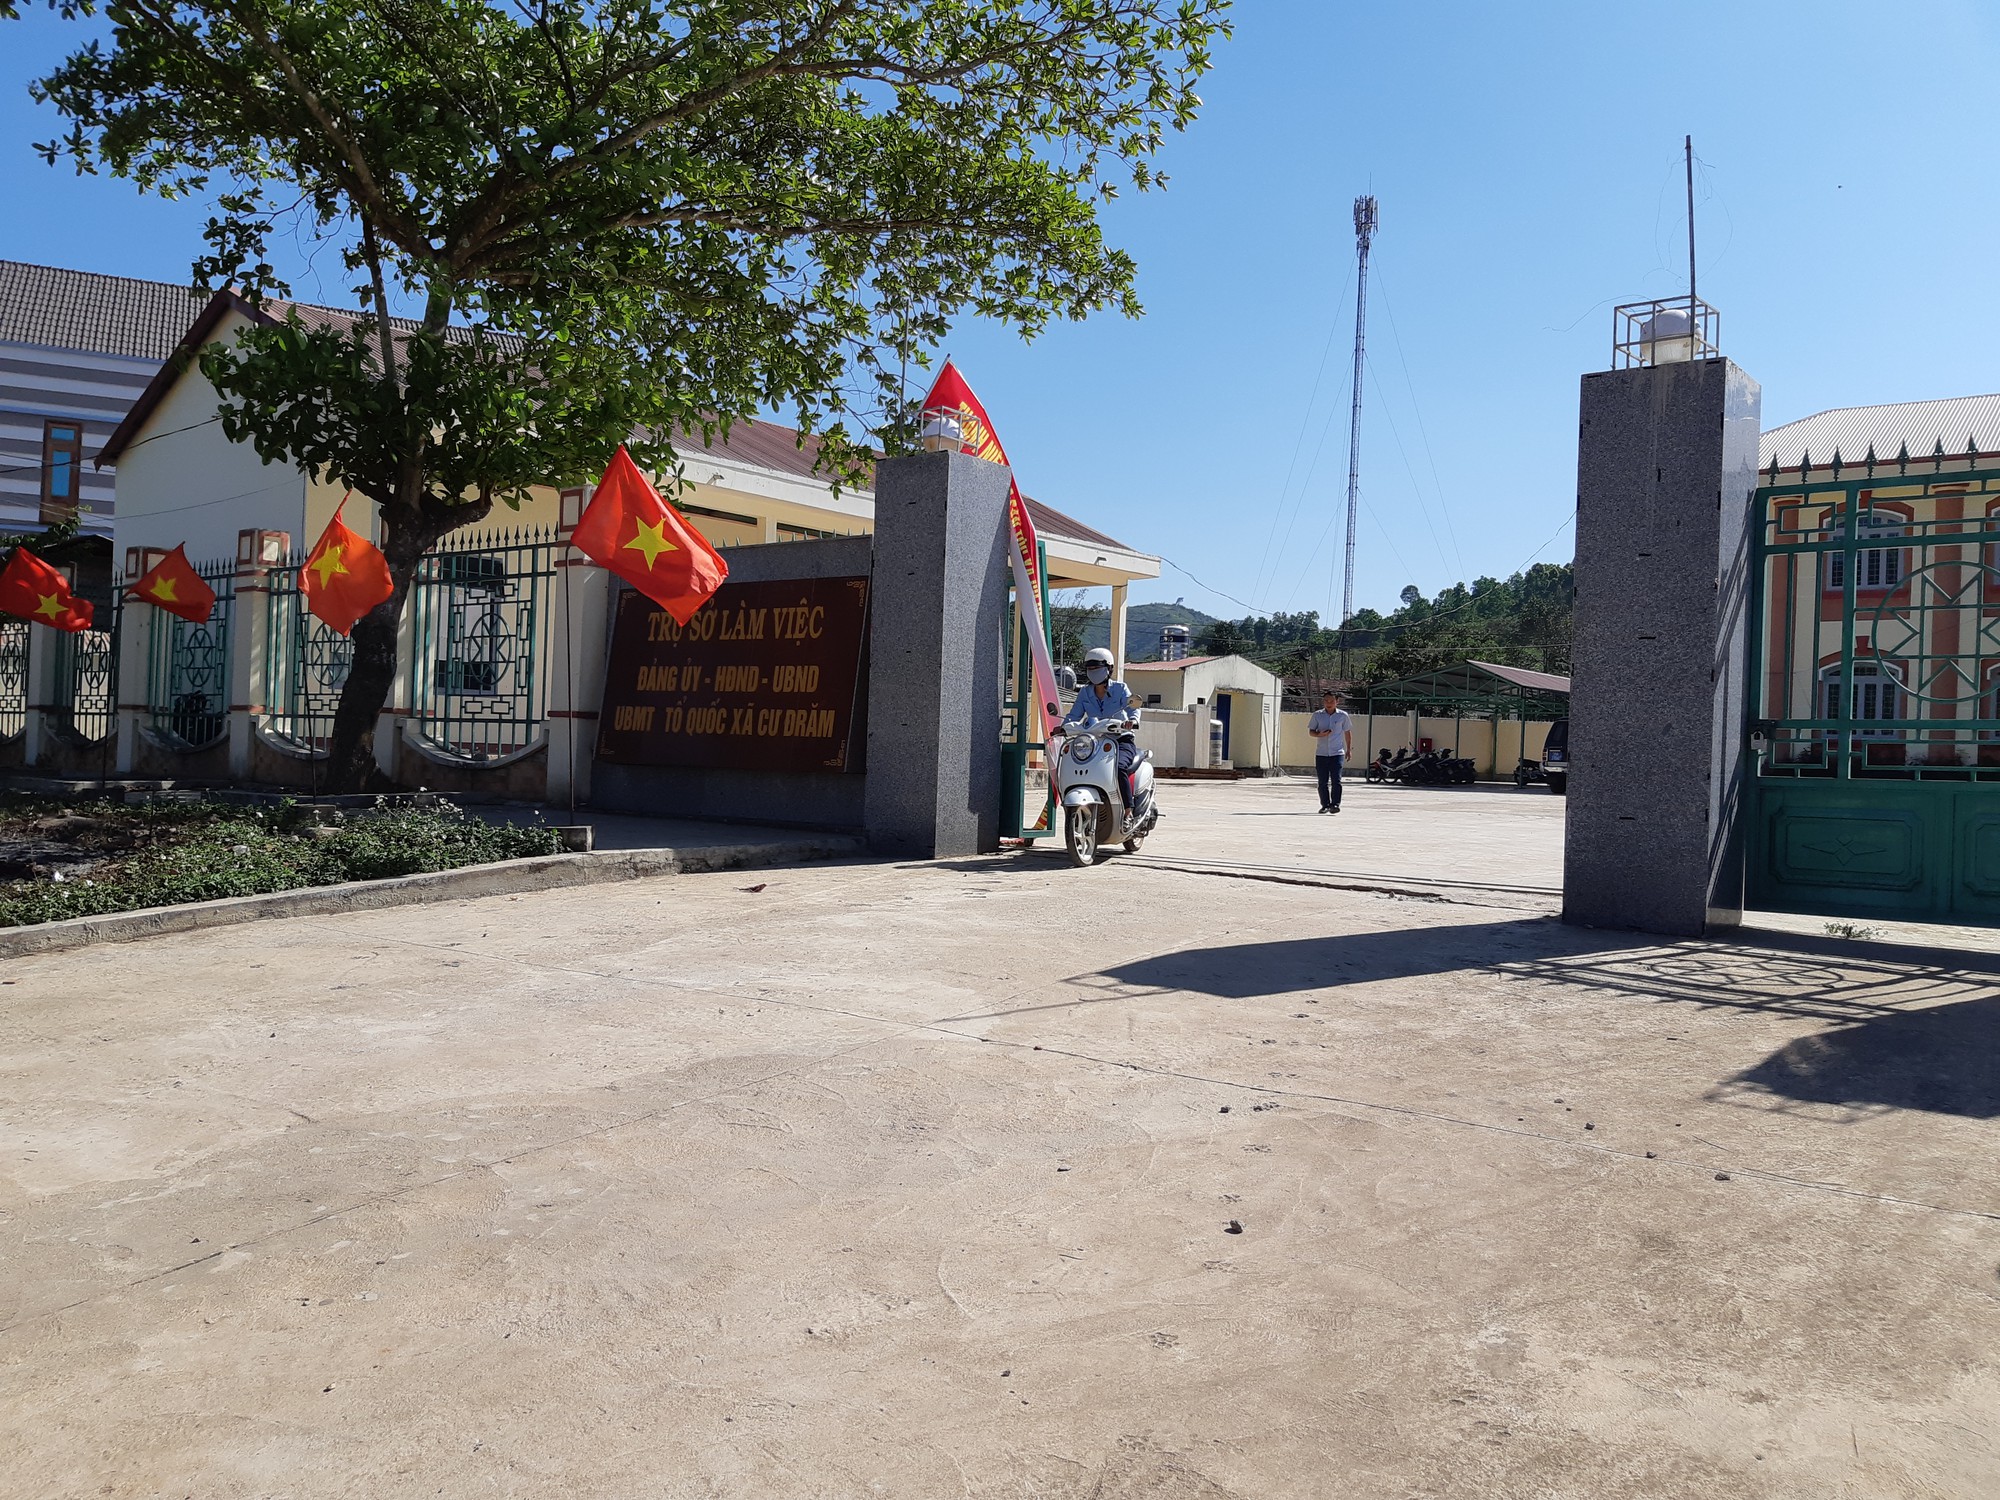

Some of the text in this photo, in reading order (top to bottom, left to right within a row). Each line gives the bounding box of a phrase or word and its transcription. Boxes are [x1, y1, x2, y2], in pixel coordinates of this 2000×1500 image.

[648, 597, 824, 648] TRỤ SỞ LÀM VIỆC
[637, 658, 678, 691] ĐẢNG
[681, 657, 702, 692] ỦY
[714, 666, 760, 692] HĐND
[773, 665, 820, 692] UBND
[614, 705, 656, 731] UBMT
[664, 695, 688, 733] TỔ
[686, 698, 727, 736] QUỐC
[730, 702, 755, 736] XÃ
[757, 708, 783, 737] CƯ
